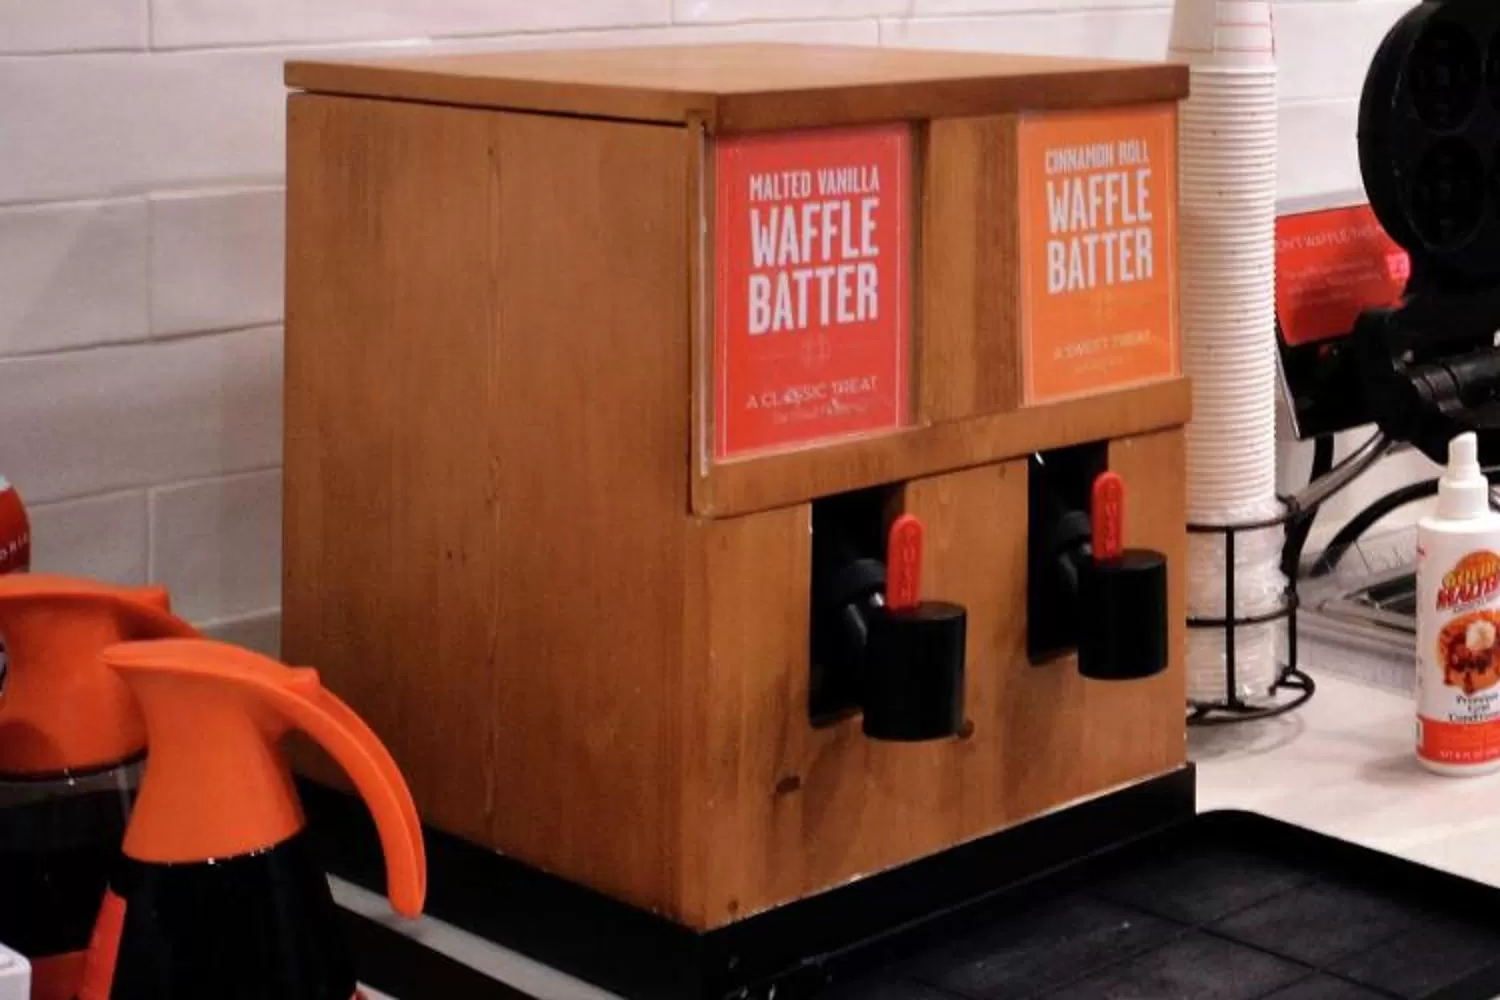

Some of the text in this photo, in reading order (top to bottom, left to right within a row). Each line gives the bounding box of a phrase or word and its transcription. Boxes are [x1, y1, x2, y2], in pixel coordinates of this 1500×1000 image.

[750, 164, 880, 201] MALTED VANILLA
[1046, 168, 1153, 233] WAFFLE
[750, 197, 880, 269] WAFFLE
[1047, 226, 1153, 295] BATTER
[748, 261, 879, 336] BATTER
